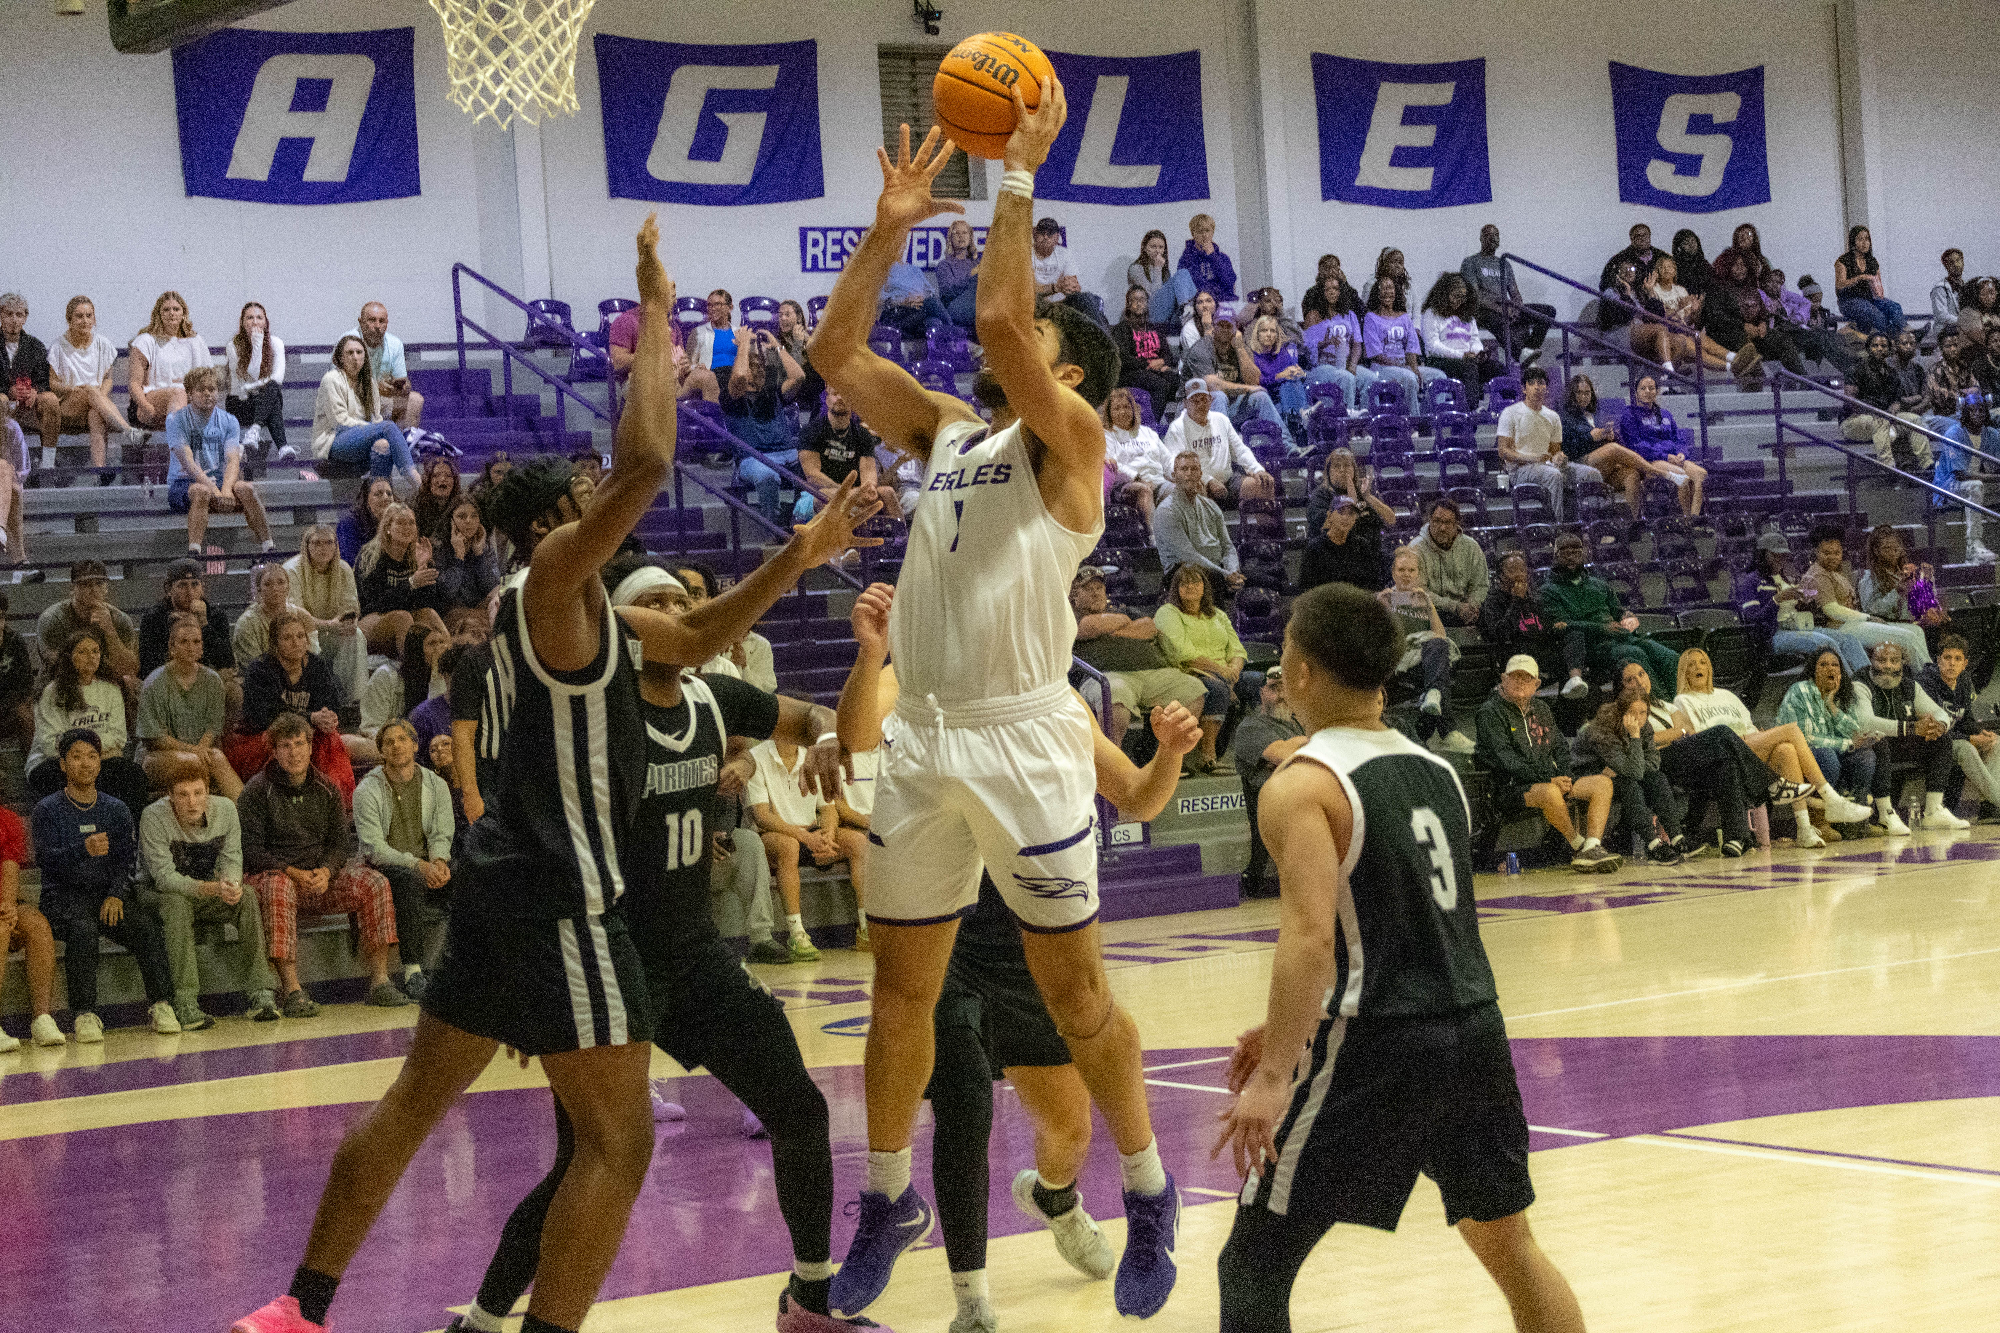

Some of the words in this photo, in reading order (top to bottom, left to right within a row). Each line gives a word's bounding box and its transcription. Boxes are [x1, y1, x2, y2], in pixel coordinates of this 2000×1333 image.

[226, 53, 376, 183] A
[646, 64, 780, 186] G
[1070, 75, 1163, 188] L
[1355, 81, 1456, 191] E
[1645, 91, 1742, 197] S
[665, 808, 703, 870] 10
[1411, 806, 1457, 911] 3
